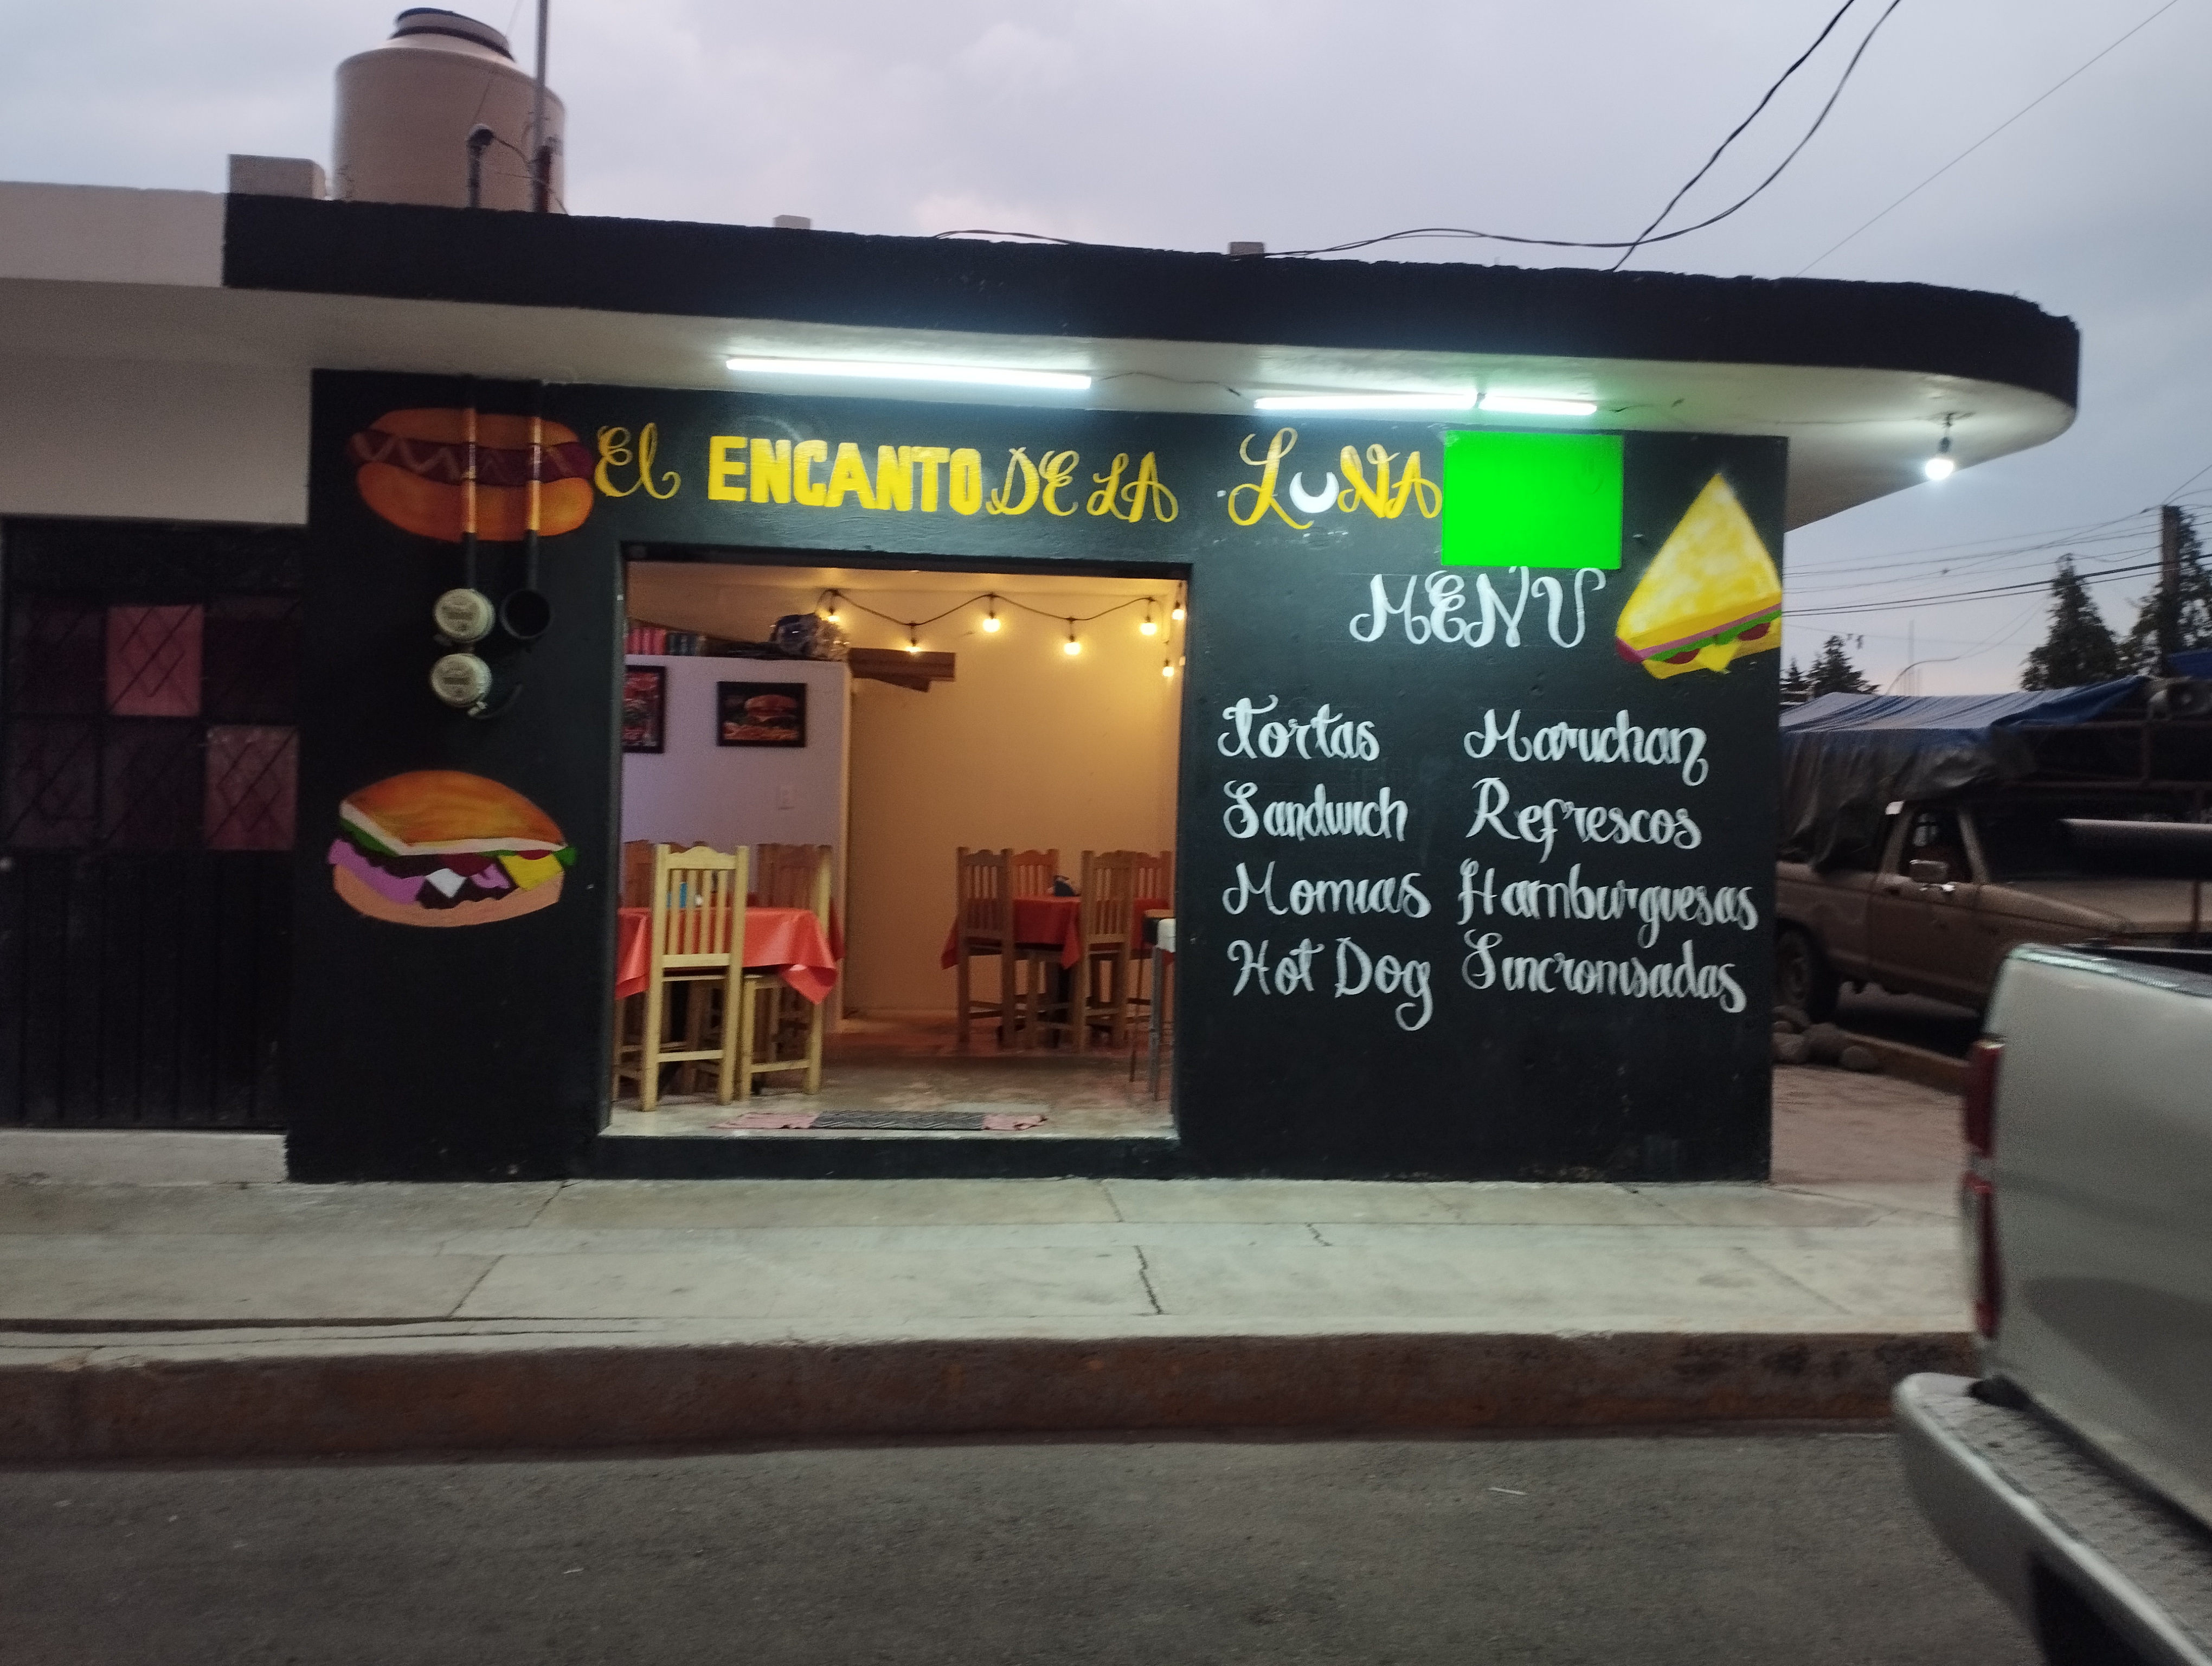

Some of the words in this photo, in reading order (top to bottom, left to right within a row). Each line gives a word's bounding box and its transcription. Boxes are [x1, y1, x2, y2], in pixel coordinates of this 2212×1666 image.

[594, 422, 681, 499] El
[708, 435, 982, 516] ENCANTO
[986, 446, 1079, 517] DE
[1086, 451, 1179, 523] LA
[1349, 565, 1606, 648] MENU
[1218, 694, 1380, 761] Tortas
[1463, 708, 1709, 787] Maruchan
[1223, 779, 1409, 842] Sandwich
[1465, 777, 1702, 863] Refrescos
[1222, 861, 1432, 918] Momias
[1457, 857, 1758, 949] Hamburguesas
[1226, 938, 1325, 997] Hot
[1334, 937, 1434, 1031] Dog
